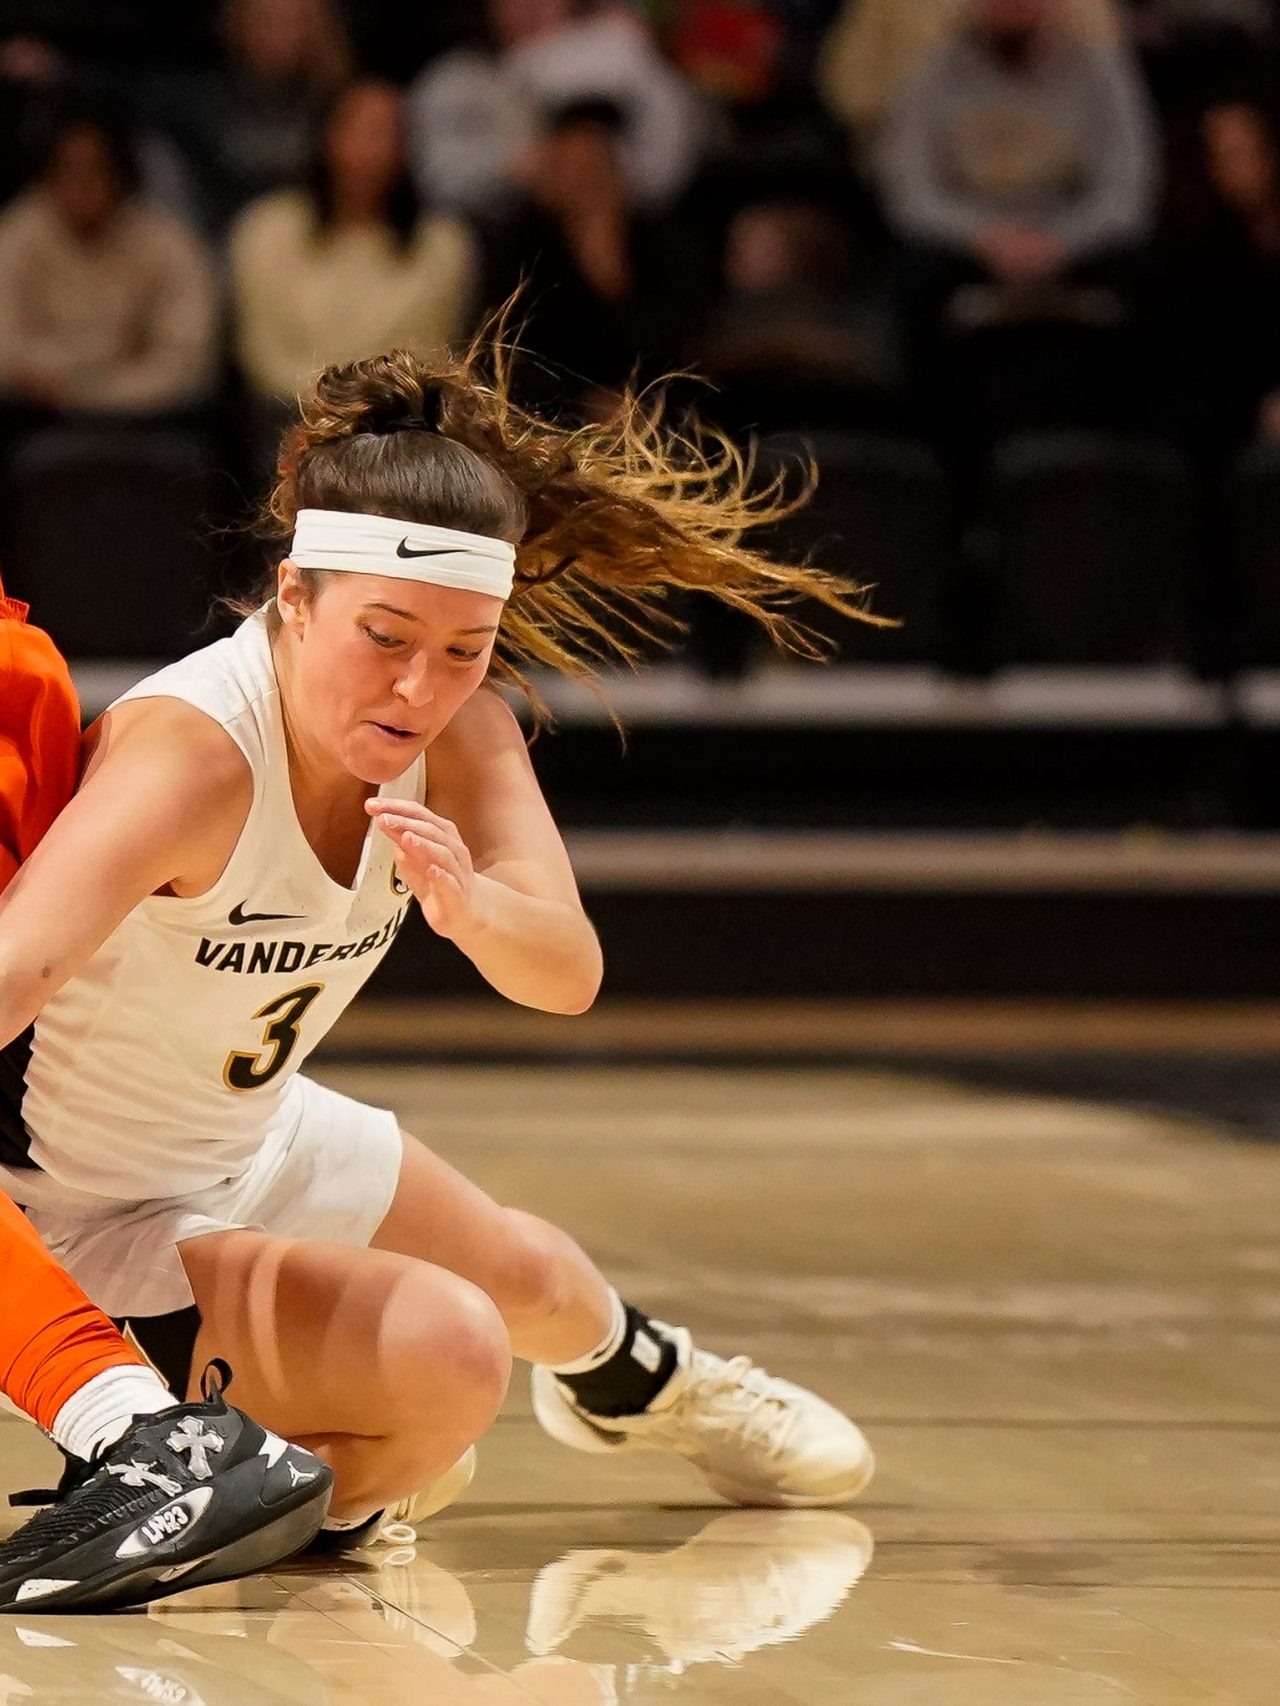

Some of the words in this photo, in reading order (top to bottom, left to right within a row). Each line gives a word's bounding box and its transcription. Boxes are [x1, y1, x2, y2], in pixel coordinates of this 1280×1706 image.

[194, 896, 410, 975] VANDERBIL
[222, 980, 326, 1092] 3
[140, 1505, 189, 1545] LM23
